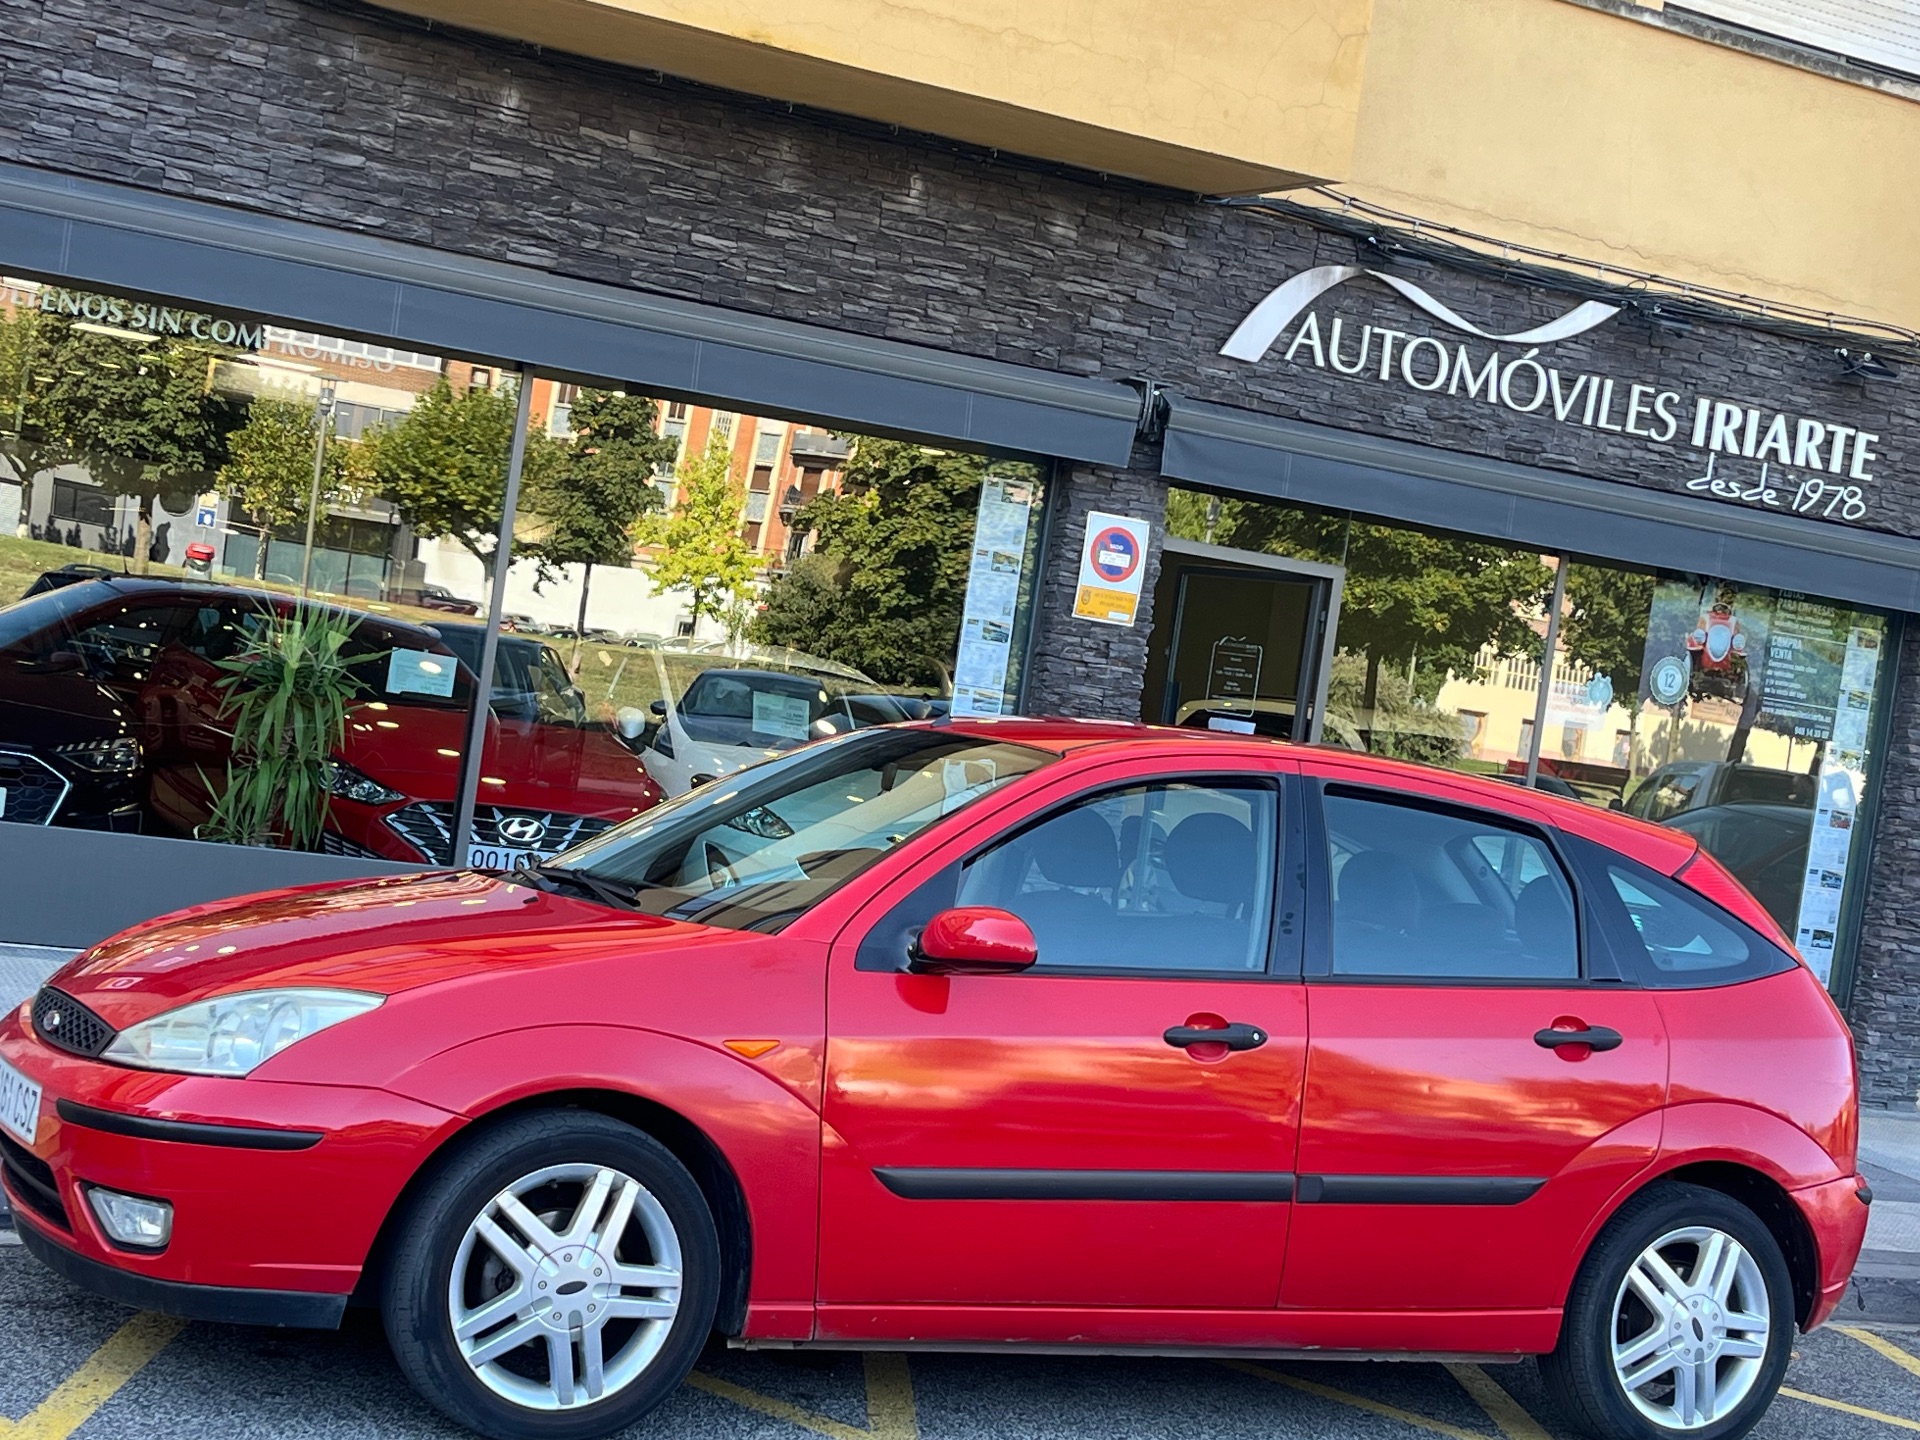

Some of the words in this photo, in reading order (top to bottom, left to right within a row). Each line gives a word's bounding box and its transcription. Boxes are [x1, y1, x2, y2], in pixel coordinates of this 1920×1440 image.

[131, 303, 184, 335] SIN
[1284, 311, 1681, 442] AUTOMÓVILES
[1690, 397, 1879, 482] IRIARTE
[1686, 452, 1780, 506] desde
[1791, 479, 1866, 520] 1978
[1769, 646, 1793, 661] VENTA
[1771, 634, 1803, 650] COMPRA
[1664, 672, 1677, 689] 12
